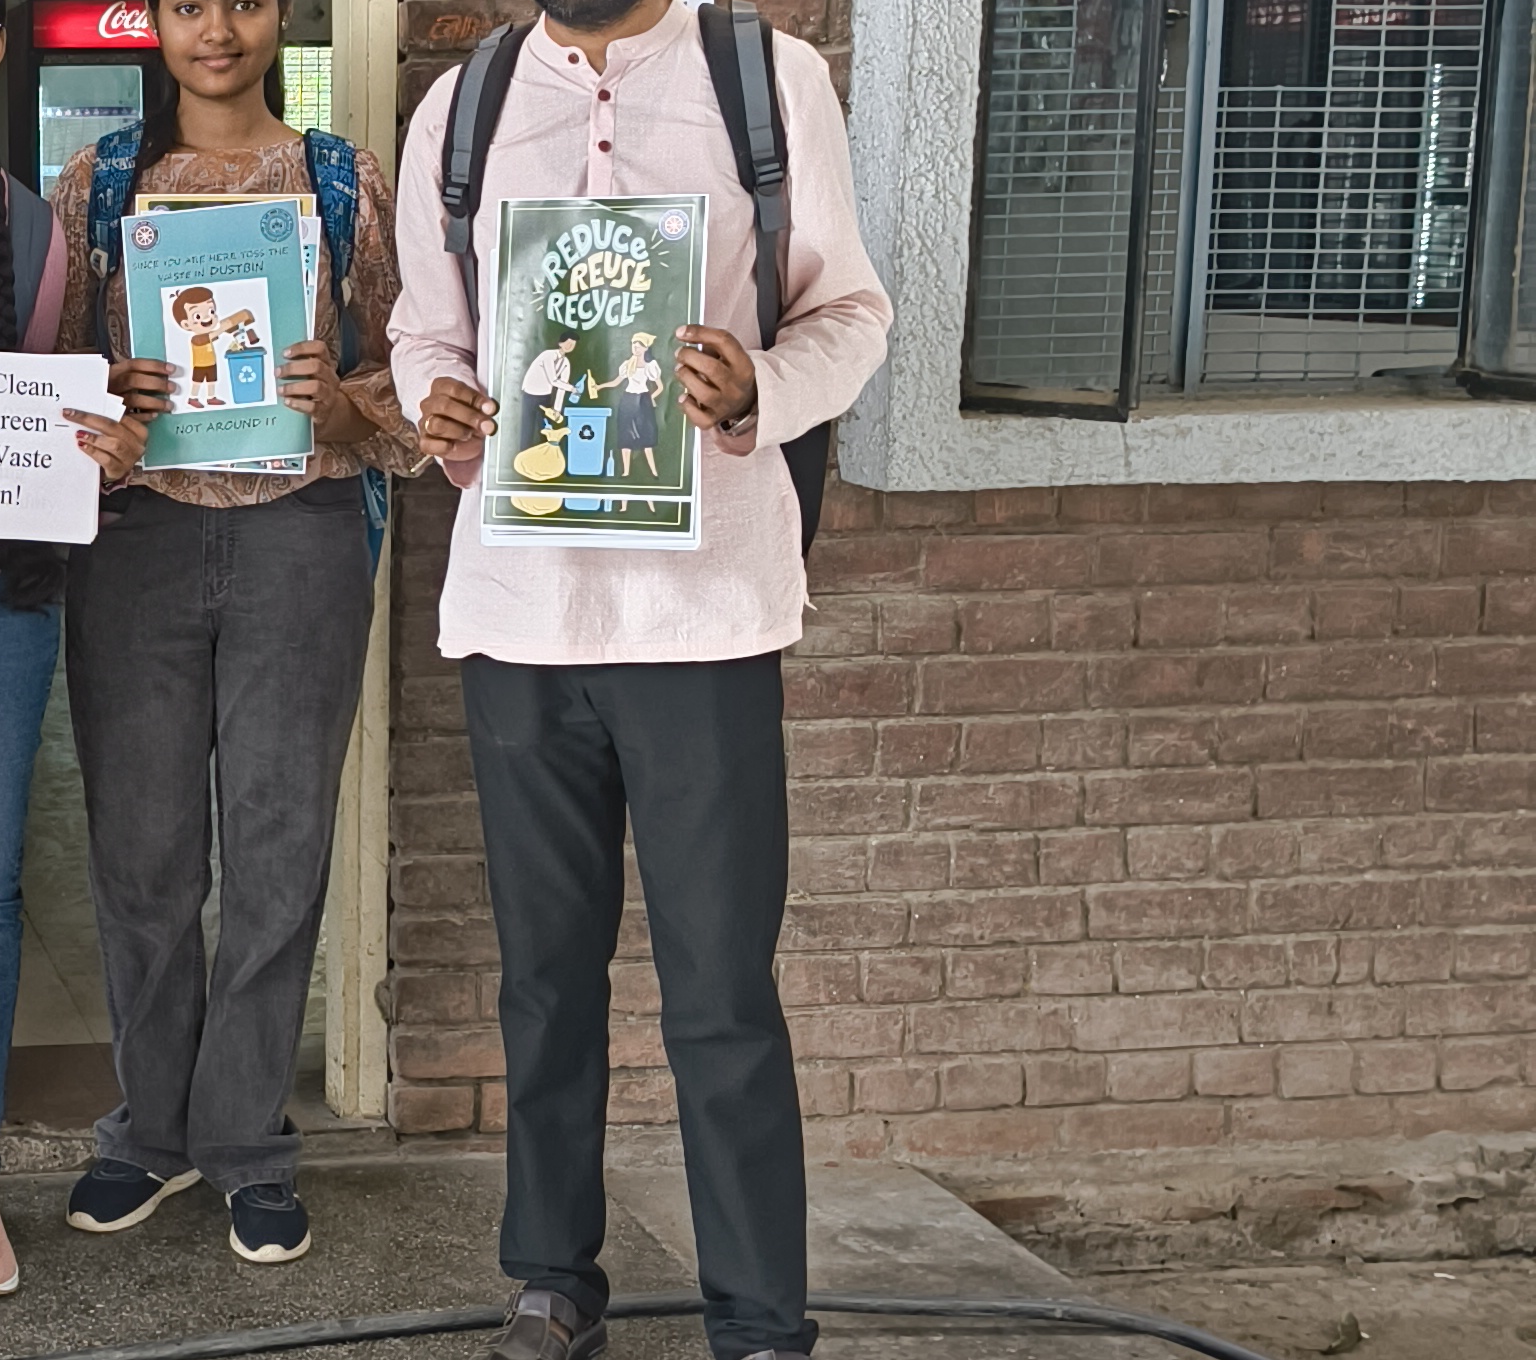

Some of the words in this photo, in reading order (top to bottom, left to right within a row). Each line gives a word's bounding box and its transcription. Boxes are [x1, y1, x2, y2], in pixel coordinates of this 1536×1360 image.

[268, 246, 289, 256] THE
[210, 261, 264, 278] DUSTBIN
[569, 251, 652, 293] REUSE
[175, 423, 202, 435] NOT
[206, 417, 262, 434] AROUND
[265, 415, 277, 426] IT
